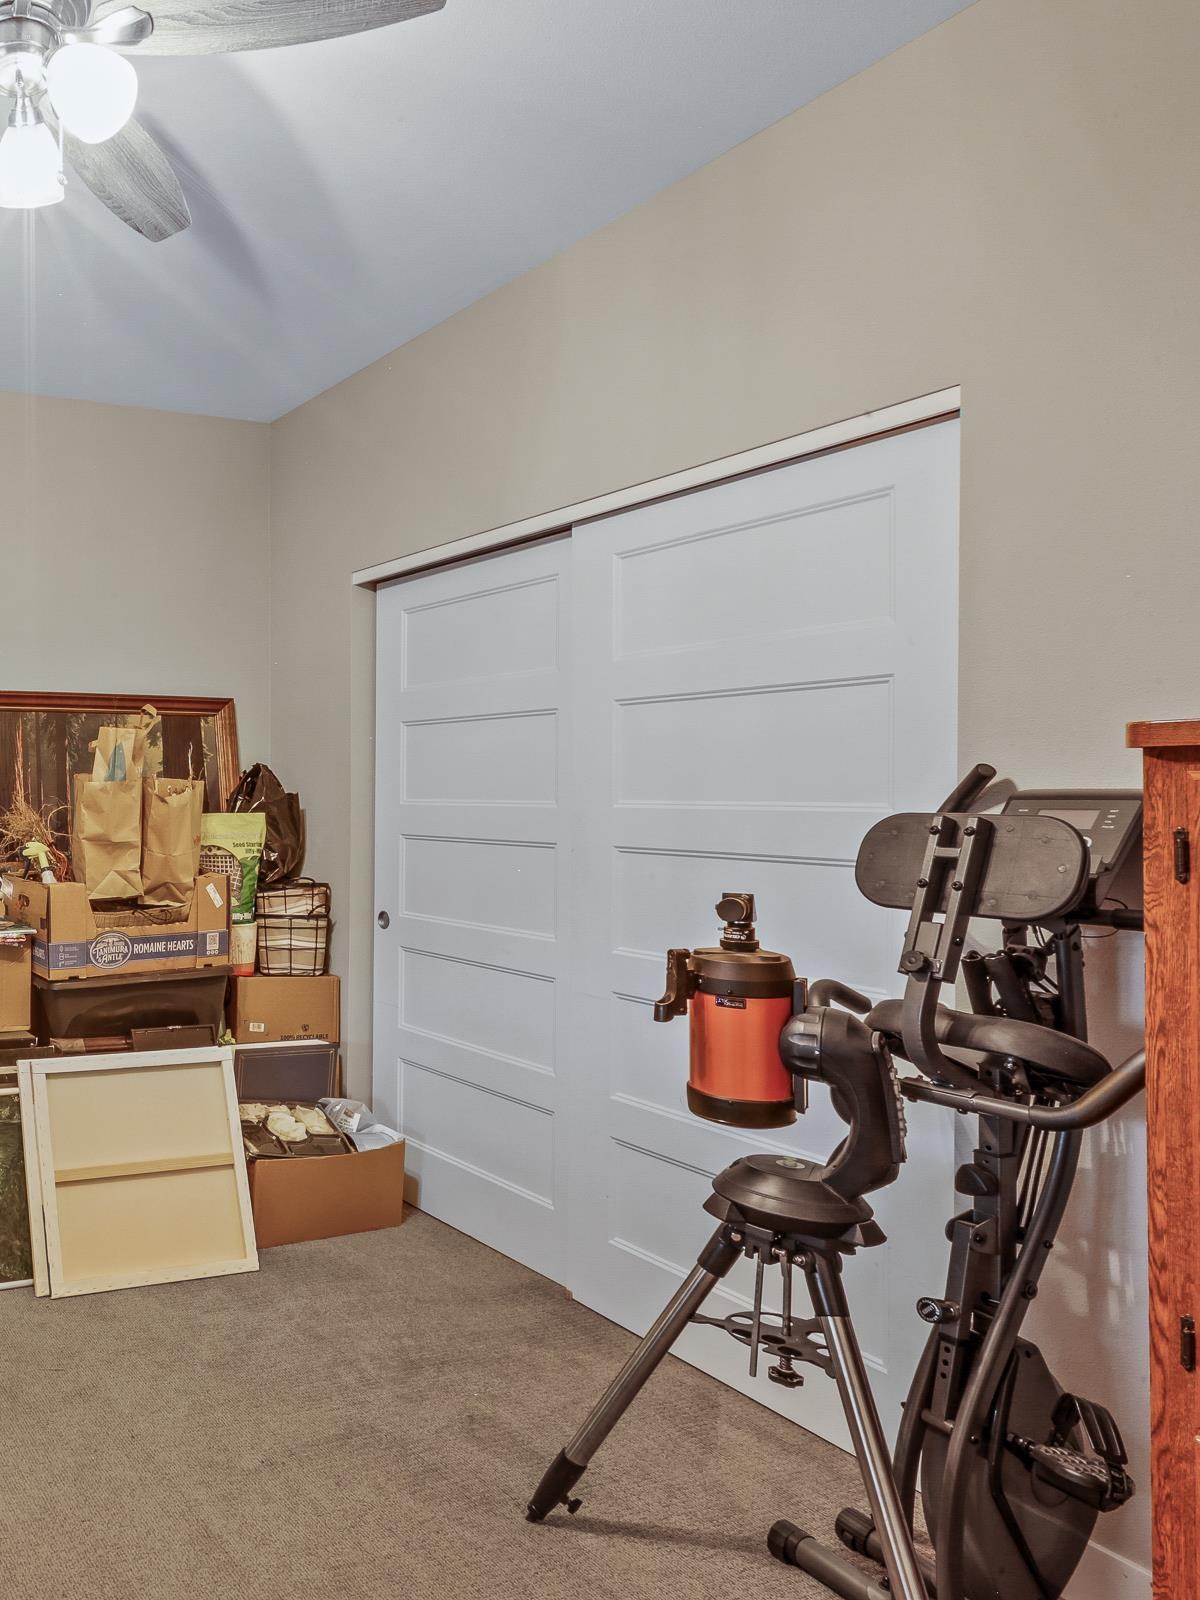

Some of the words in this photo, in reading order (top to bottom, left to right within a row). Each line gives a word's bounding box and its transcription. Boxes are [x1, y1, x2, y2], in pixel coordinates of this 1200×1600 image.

[92, 945, 130, 960] TANIMURA
[133, 942, 166, 955] ROMAINE
[167, 939, 194, 952] HEARTS
